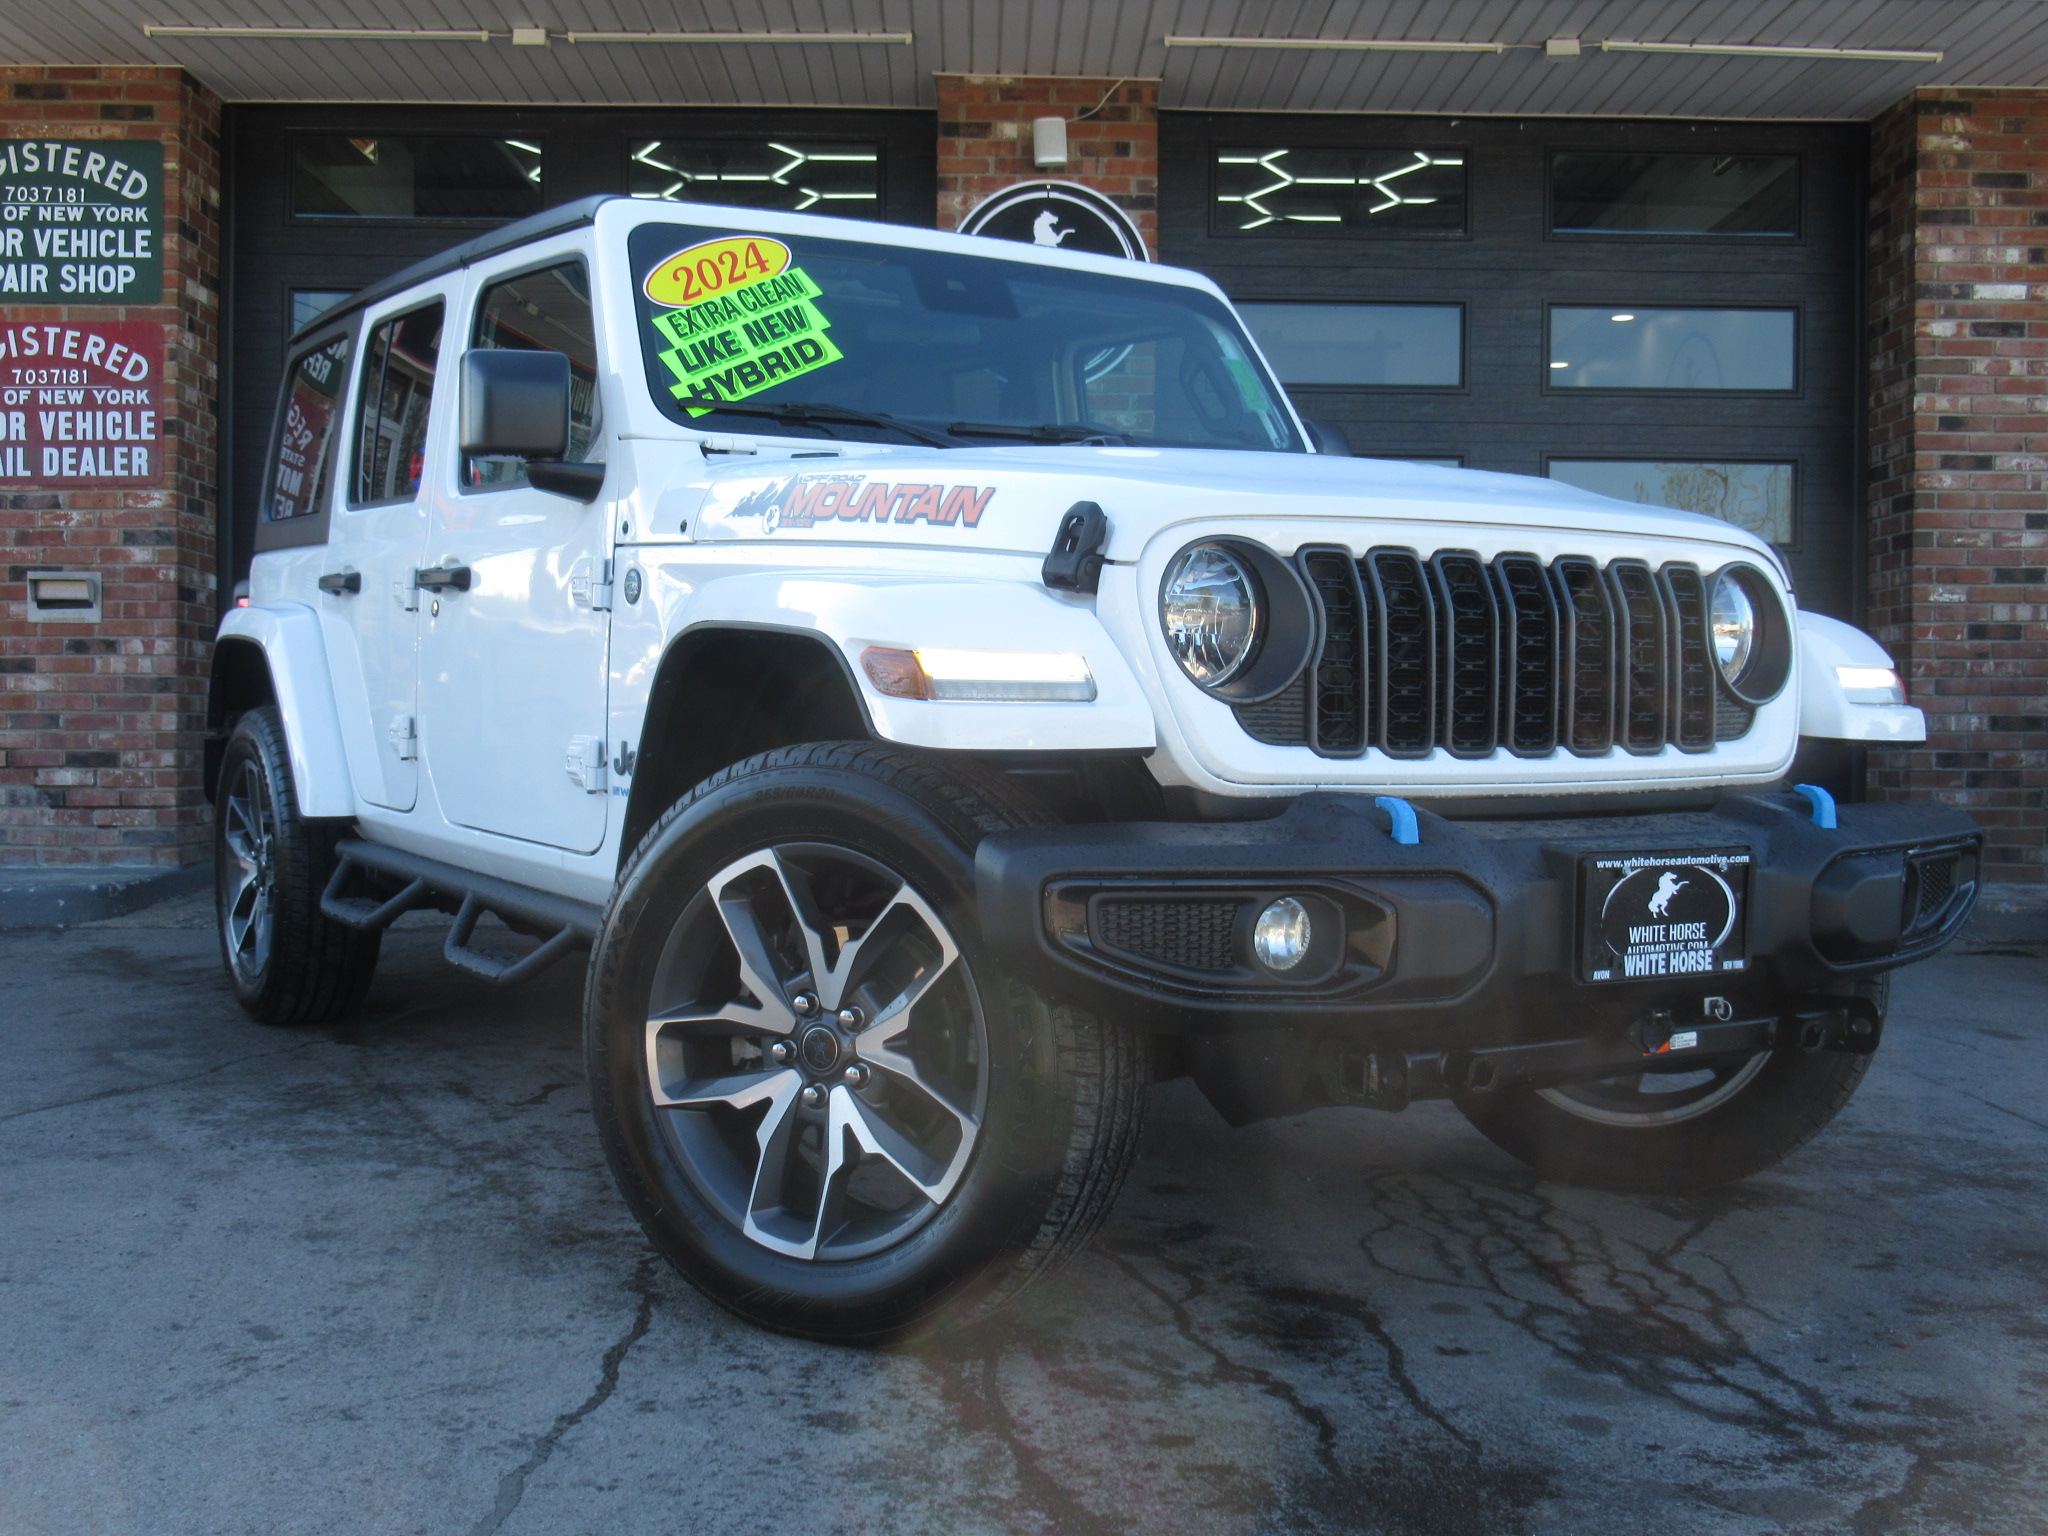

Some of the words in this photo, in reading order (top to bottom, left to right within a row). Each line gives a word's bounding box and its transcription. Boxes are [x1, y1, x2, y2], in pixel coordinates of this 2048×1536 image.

[5, 186, 86, 203] 7037181
[4, 207, 30, 222] OF
[39, 207, 85, 222] NEW
[92, 207, 148, 222] YORK
[33, 229, 152, 258] VEHICLE
[60, 265, 136, 293] SHOP
[672, 241, 770, 301] 2024
[666, 295, 744, 339] EXTRA
[737, 272, 807, 313] CLEAN
[675, 330, 744, 374] LIKE
[742, 305, 808, 348] NEW
[11, 369, 88, 384] 7037181
[686, 338, 825, 400] HYBRID
[4, 390, 31, 405] OF
[39, 390, 85, 405] NEW
[92, 390, 150, 405] YORK
[40, 411, 155, 441] VEHICLE
[43, 447, 149, 477] DEALER
[781, 482, 996, 528] MOUNTAIN
[1596, 854, 1750, 869] www.whitehorseautomotive.com
[1629, 925, 1666, 943] WHITE
[1669, 922, 1706, 940] HORSE
[1593, 970, 1610, 981] AVON
[1624, 953, 1666, 976] WHITE
[1669, 950, 1713, 973] HORSE
